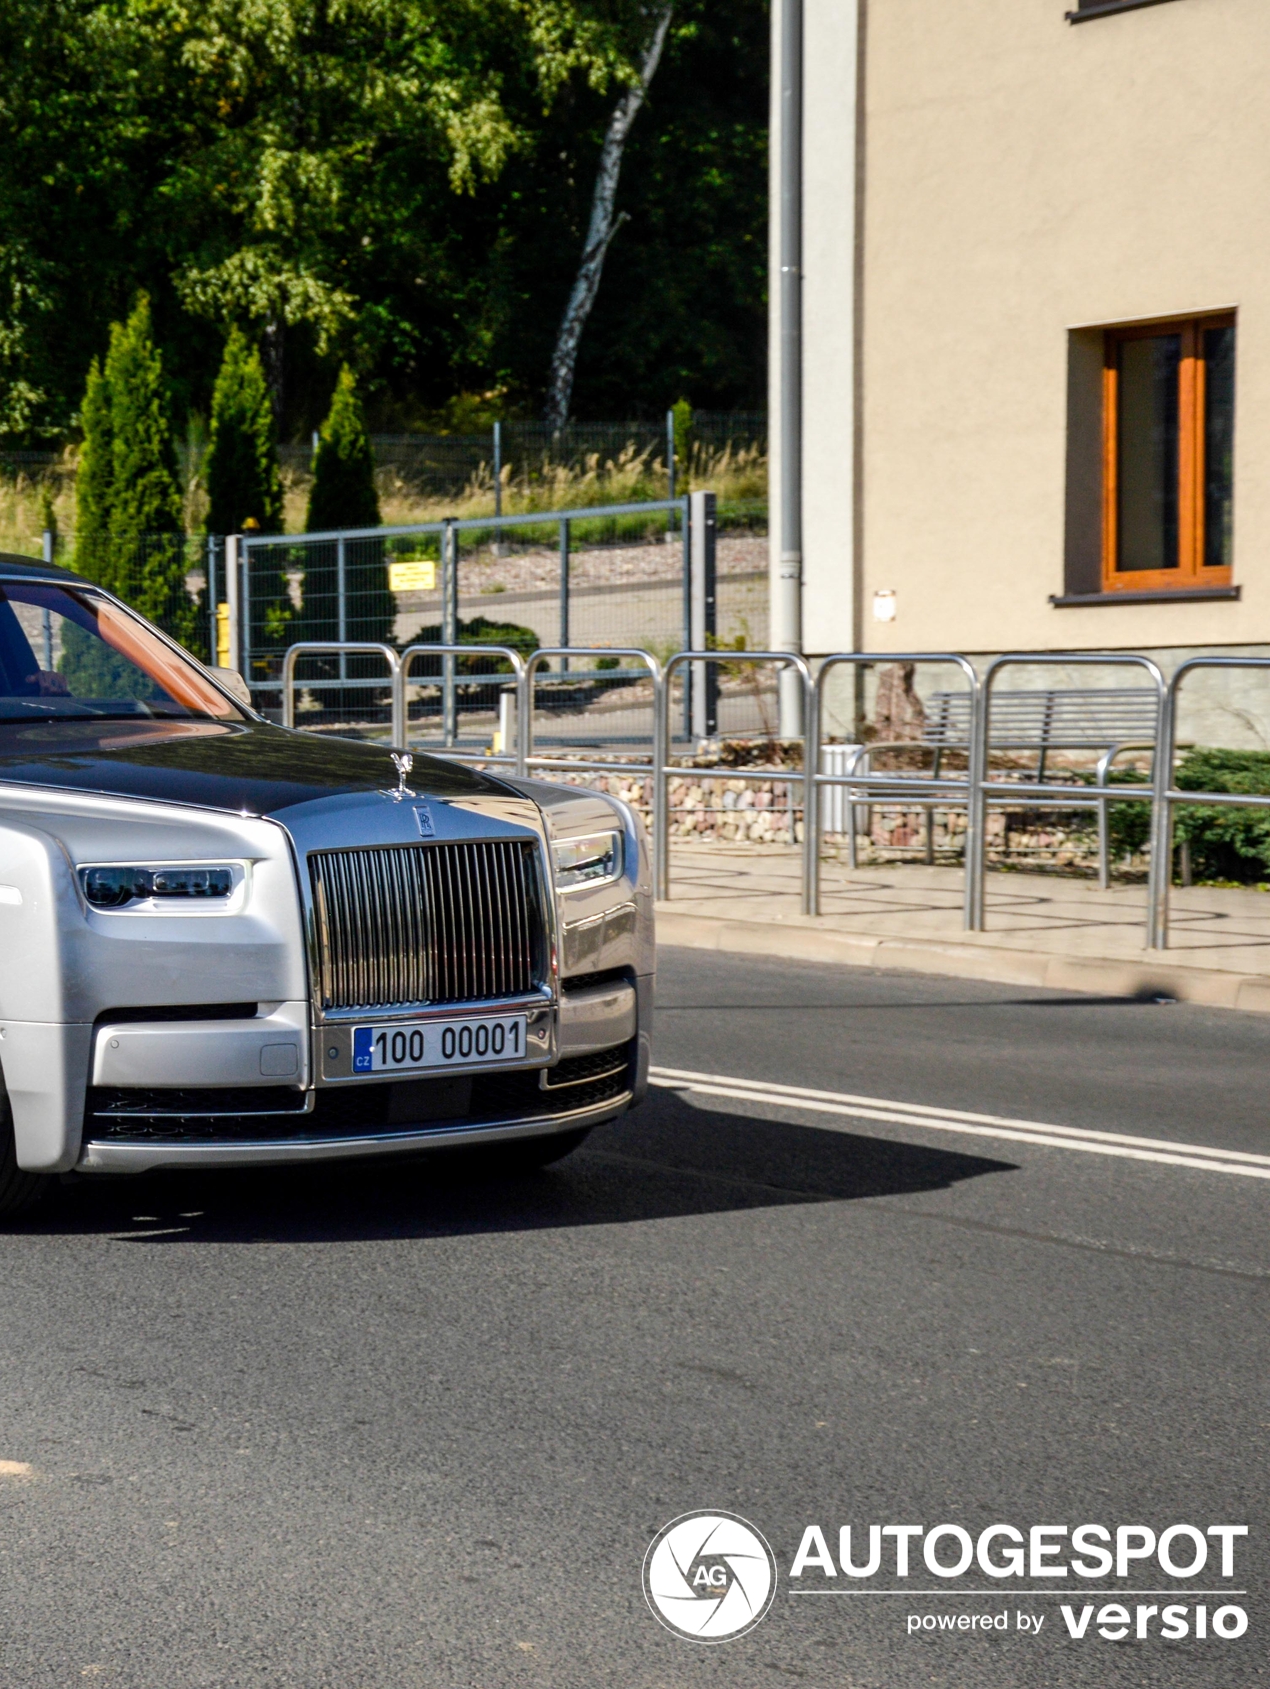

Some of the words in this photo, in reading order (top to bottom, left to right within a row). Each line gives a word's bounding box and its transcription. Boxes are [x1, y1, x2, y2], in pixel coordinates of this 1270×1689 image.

[376, 1029, 424, 1065] 100
[442, 1021, 520, 1059] 00001
[356, 1056, 370, 1067] CZ
